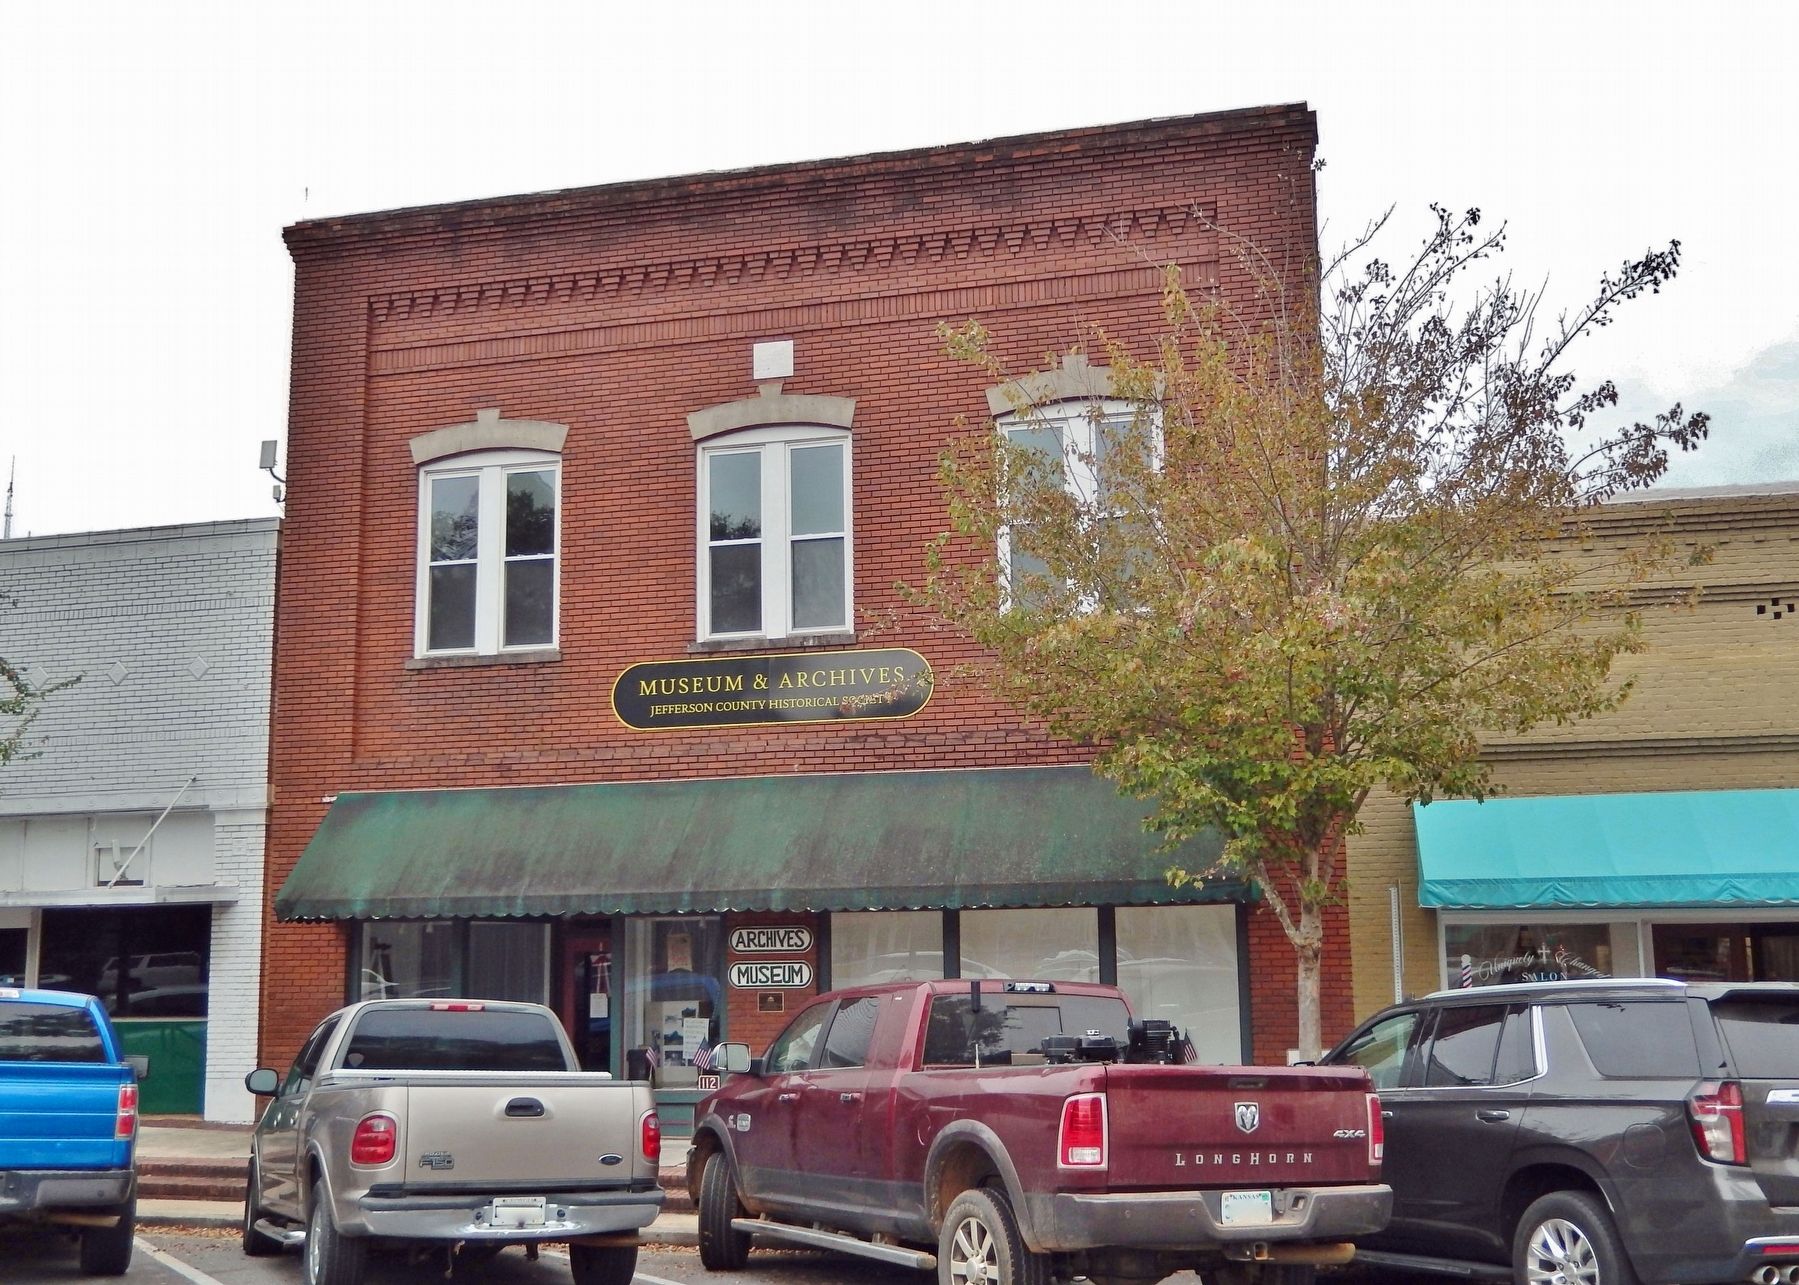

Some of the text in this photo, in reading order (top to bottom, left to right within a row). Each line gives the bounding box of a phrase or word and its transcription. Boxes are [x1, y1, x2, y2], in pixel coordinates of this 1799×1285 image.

[639, 666, 905, 696] MUSEUM & ARCHIVES
[650, 702, 713, 718] JEFFERSON
[716, 699, 766, 712] COUNTY
[769, 696, 839, 710] HISTORICAL
[735, 929, 805, 948] ARCHIVES
[737, 965, 804, 984] MUSEUM
[1521, 971, 1568, 982] SALON
[701, 1077, 717, 1089] 112
[1175, 1152, 1313, 1166] LONGHORN
